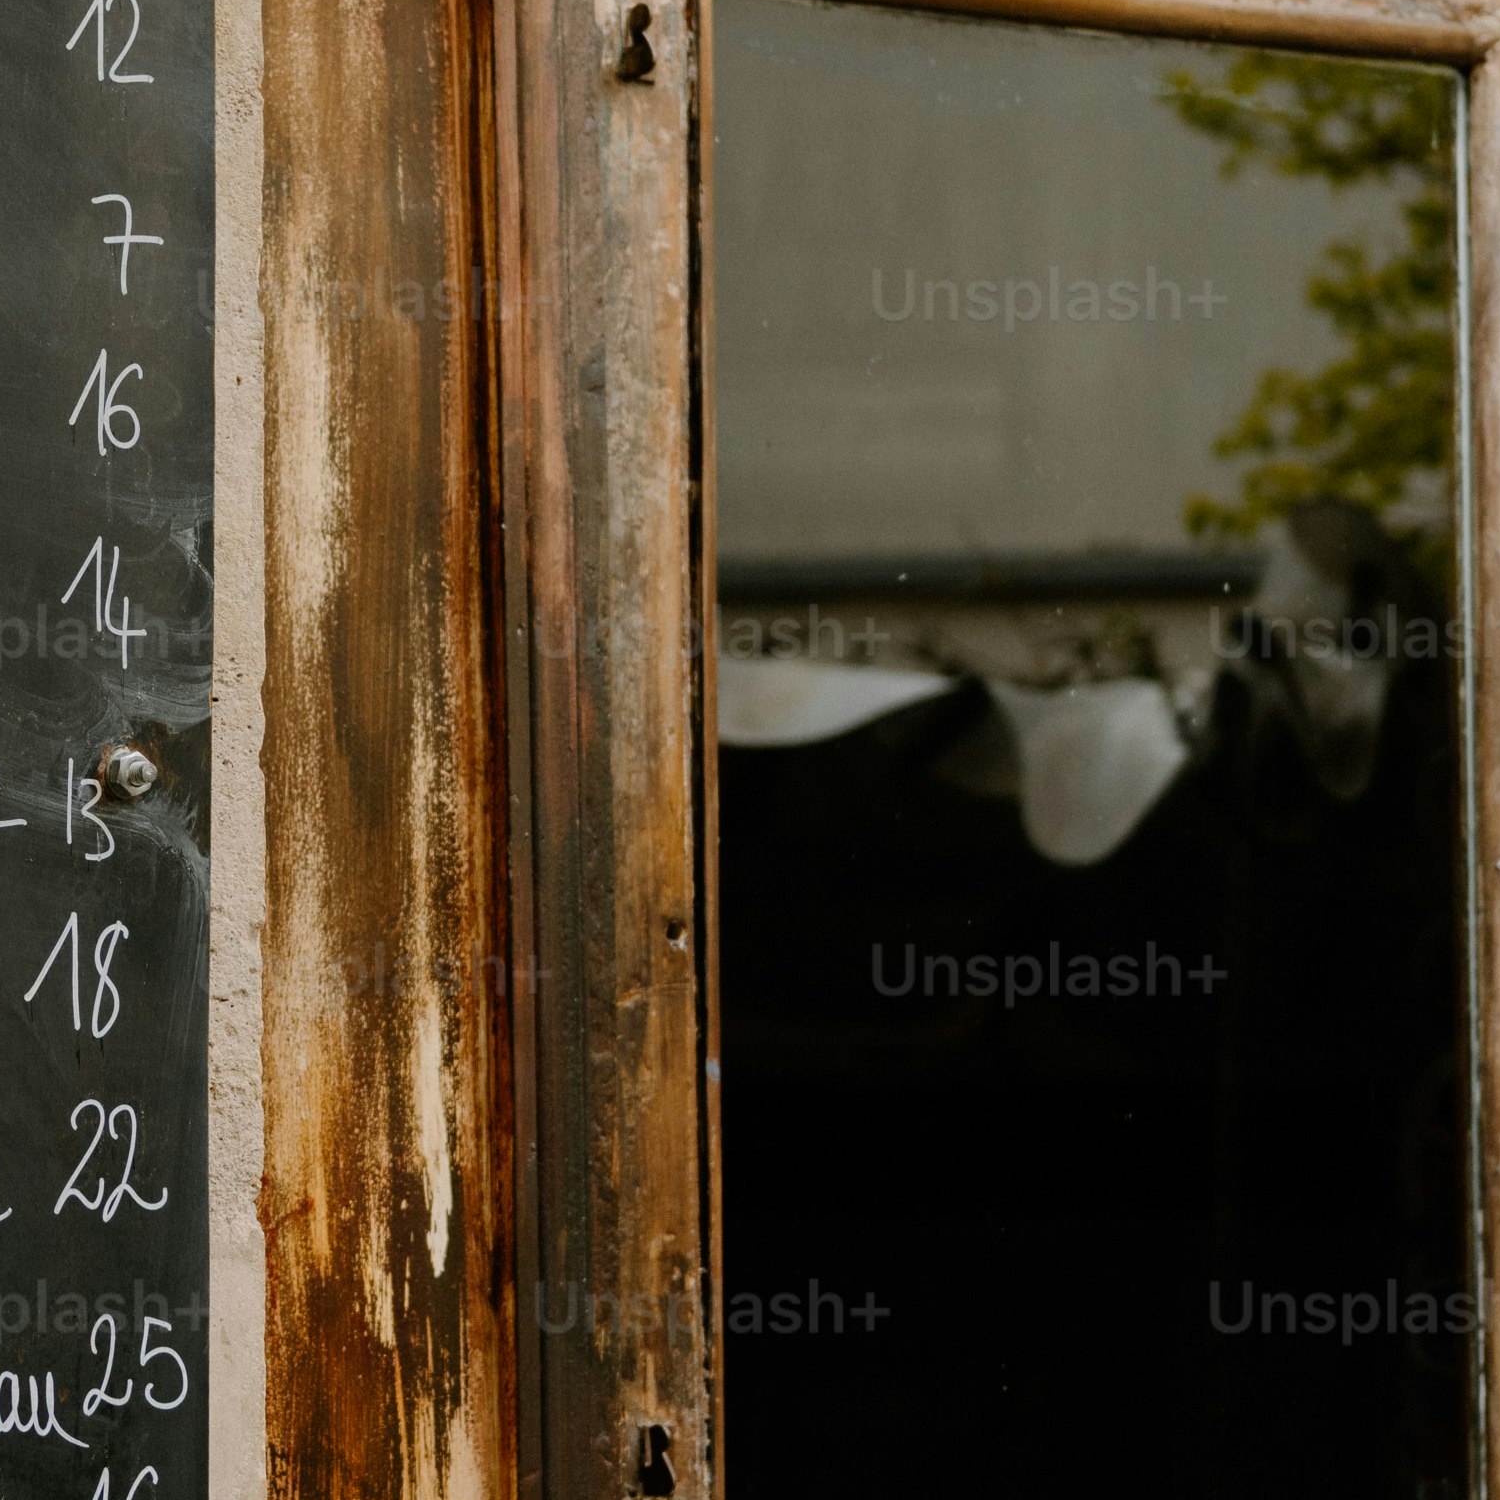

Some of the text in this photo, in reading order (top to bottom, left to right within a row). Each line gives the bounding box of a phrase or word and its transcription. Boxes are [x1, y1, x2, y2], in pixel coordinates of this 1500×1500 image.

[90, 192, 164, 295] 7
[68, 348, 144, 456] 16
[61, 535, 148, 671] 14
[66, 756, 116, 862] 13
[23, 910, 131, 1038] 18
[54, 1099, 170, 1215] 22
[83, 1312, 190, 1418] 25
